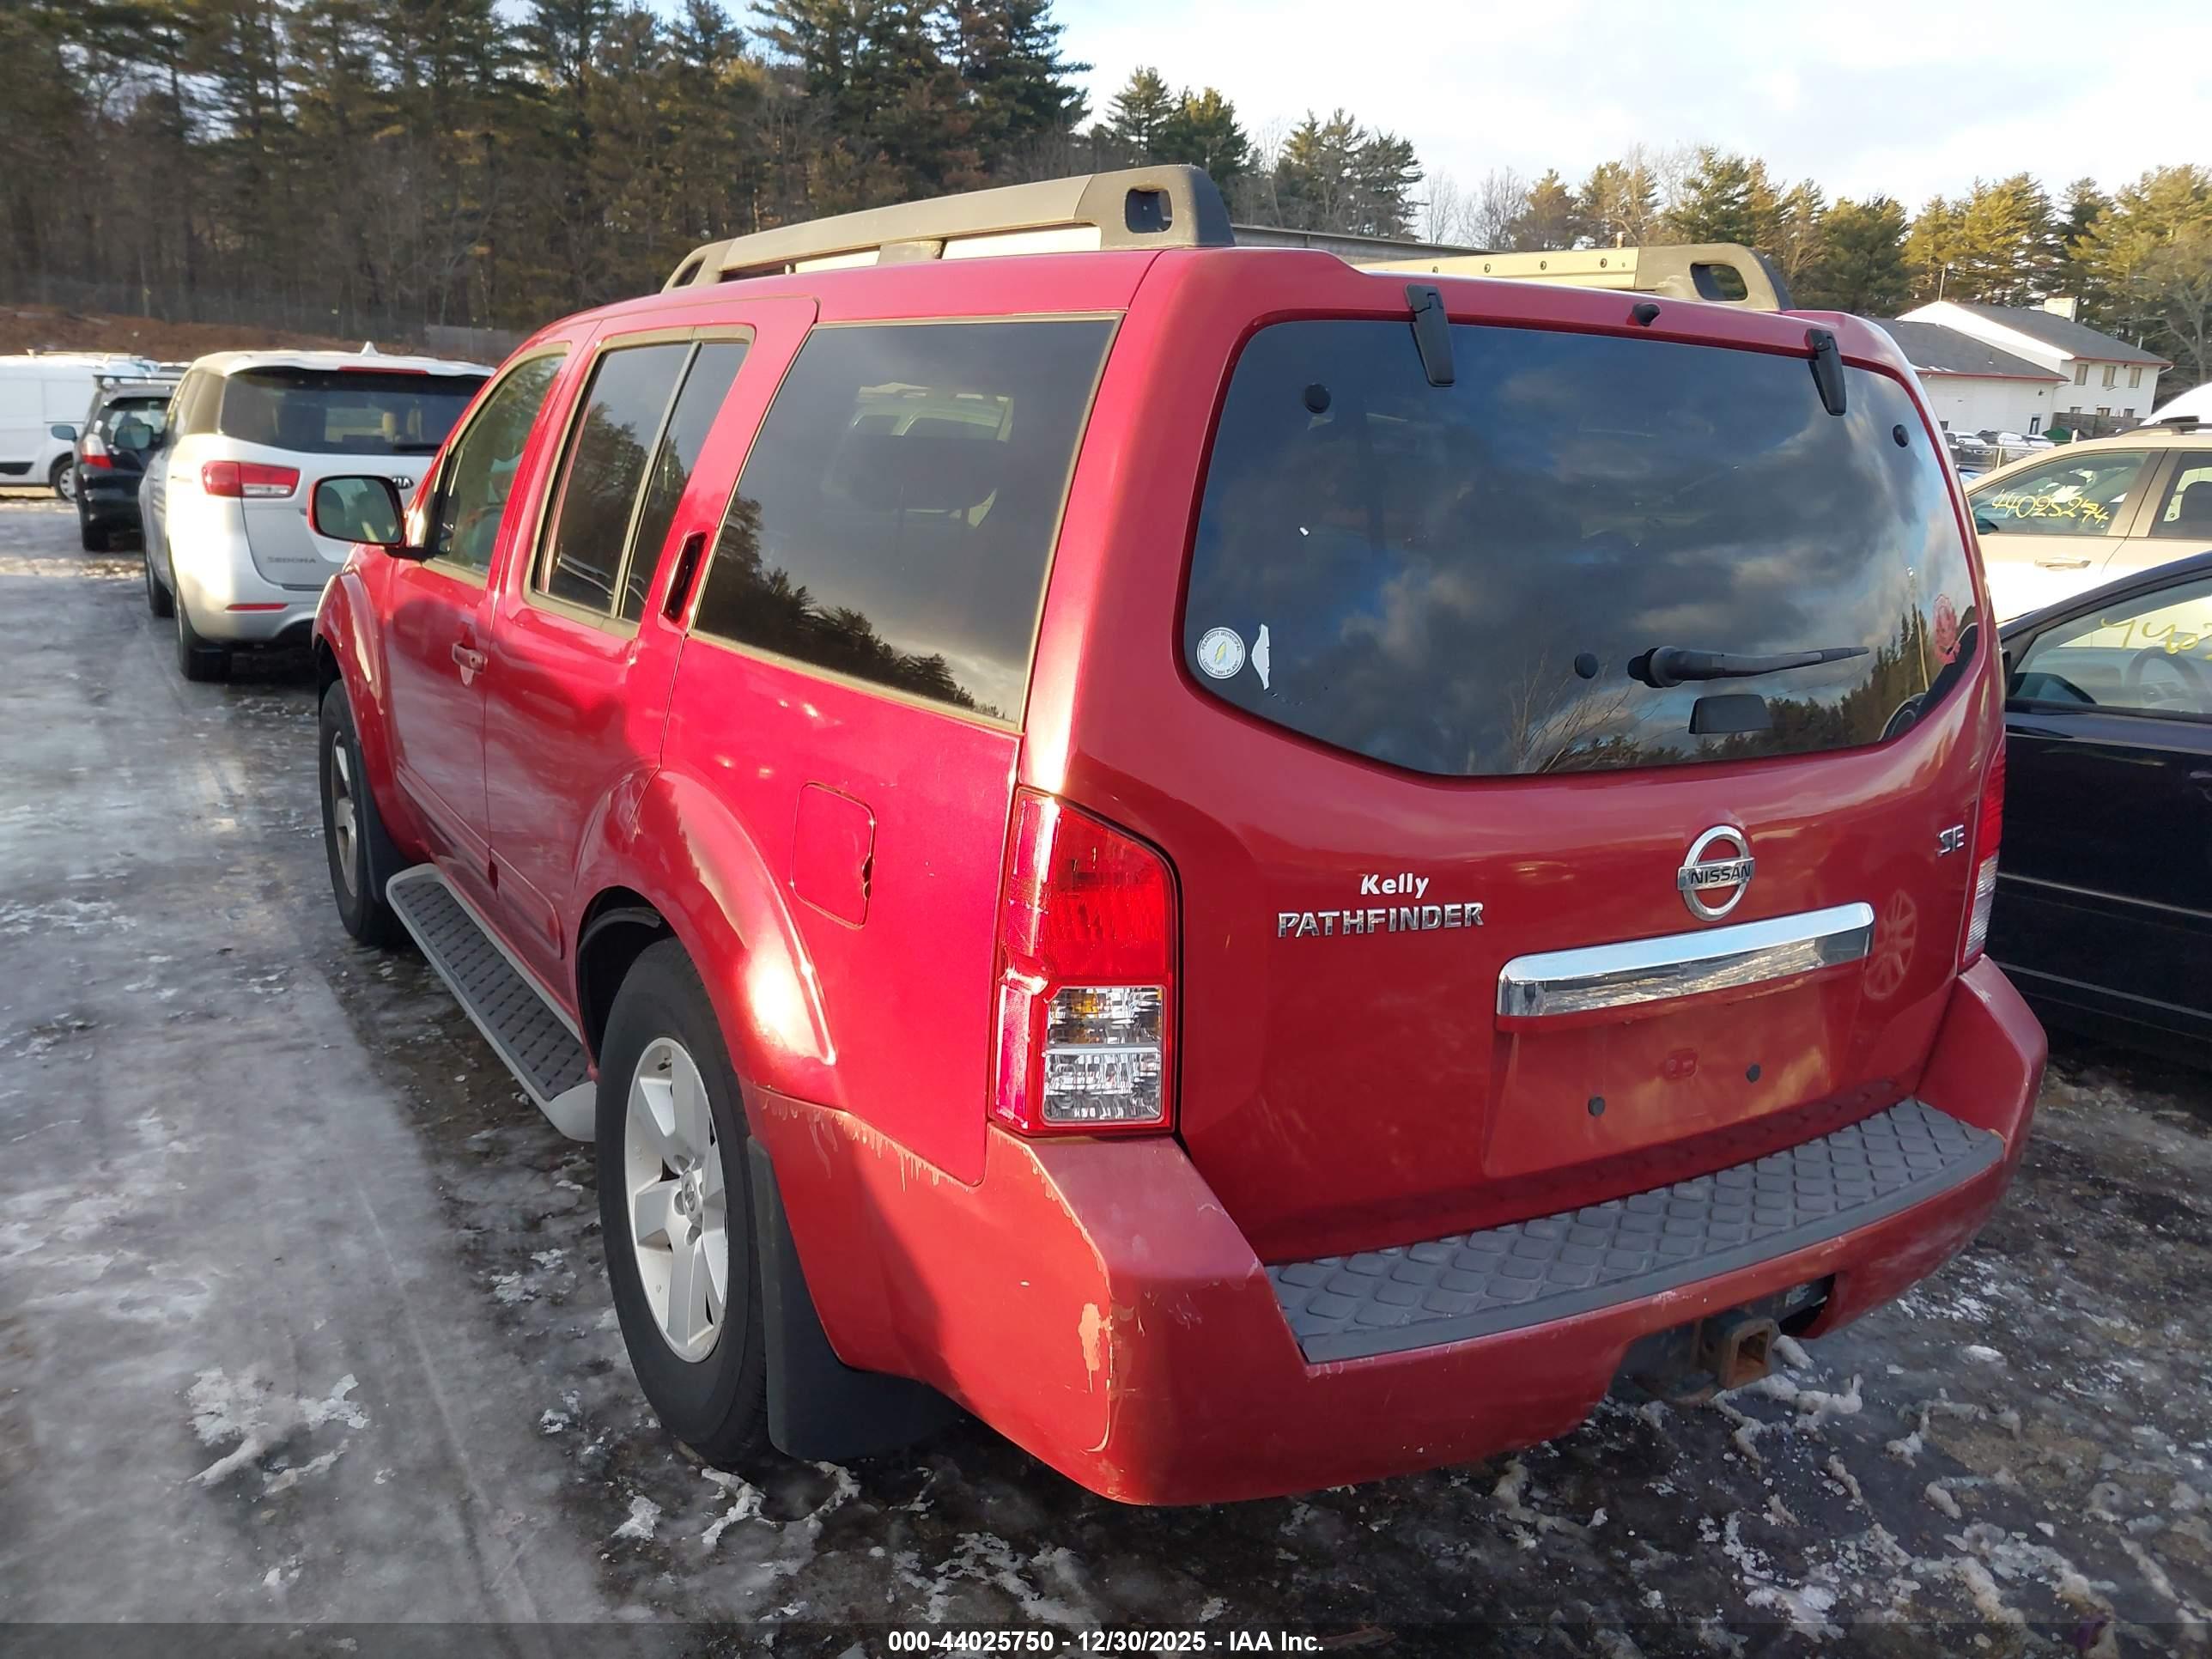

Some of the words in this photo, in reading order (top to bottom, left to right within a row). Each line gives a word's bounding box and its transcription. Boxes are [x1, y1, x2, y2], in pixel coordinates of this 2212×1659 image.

[1991, 489, 2109, 525] 44025274
[1937, 824, 1966, 857] SE
[1360, 872, 1430, 899] Kelly
[1690, 865, 1752, 884] NISSAN
[1277, 902, 1485, 939] PATHFINDER
